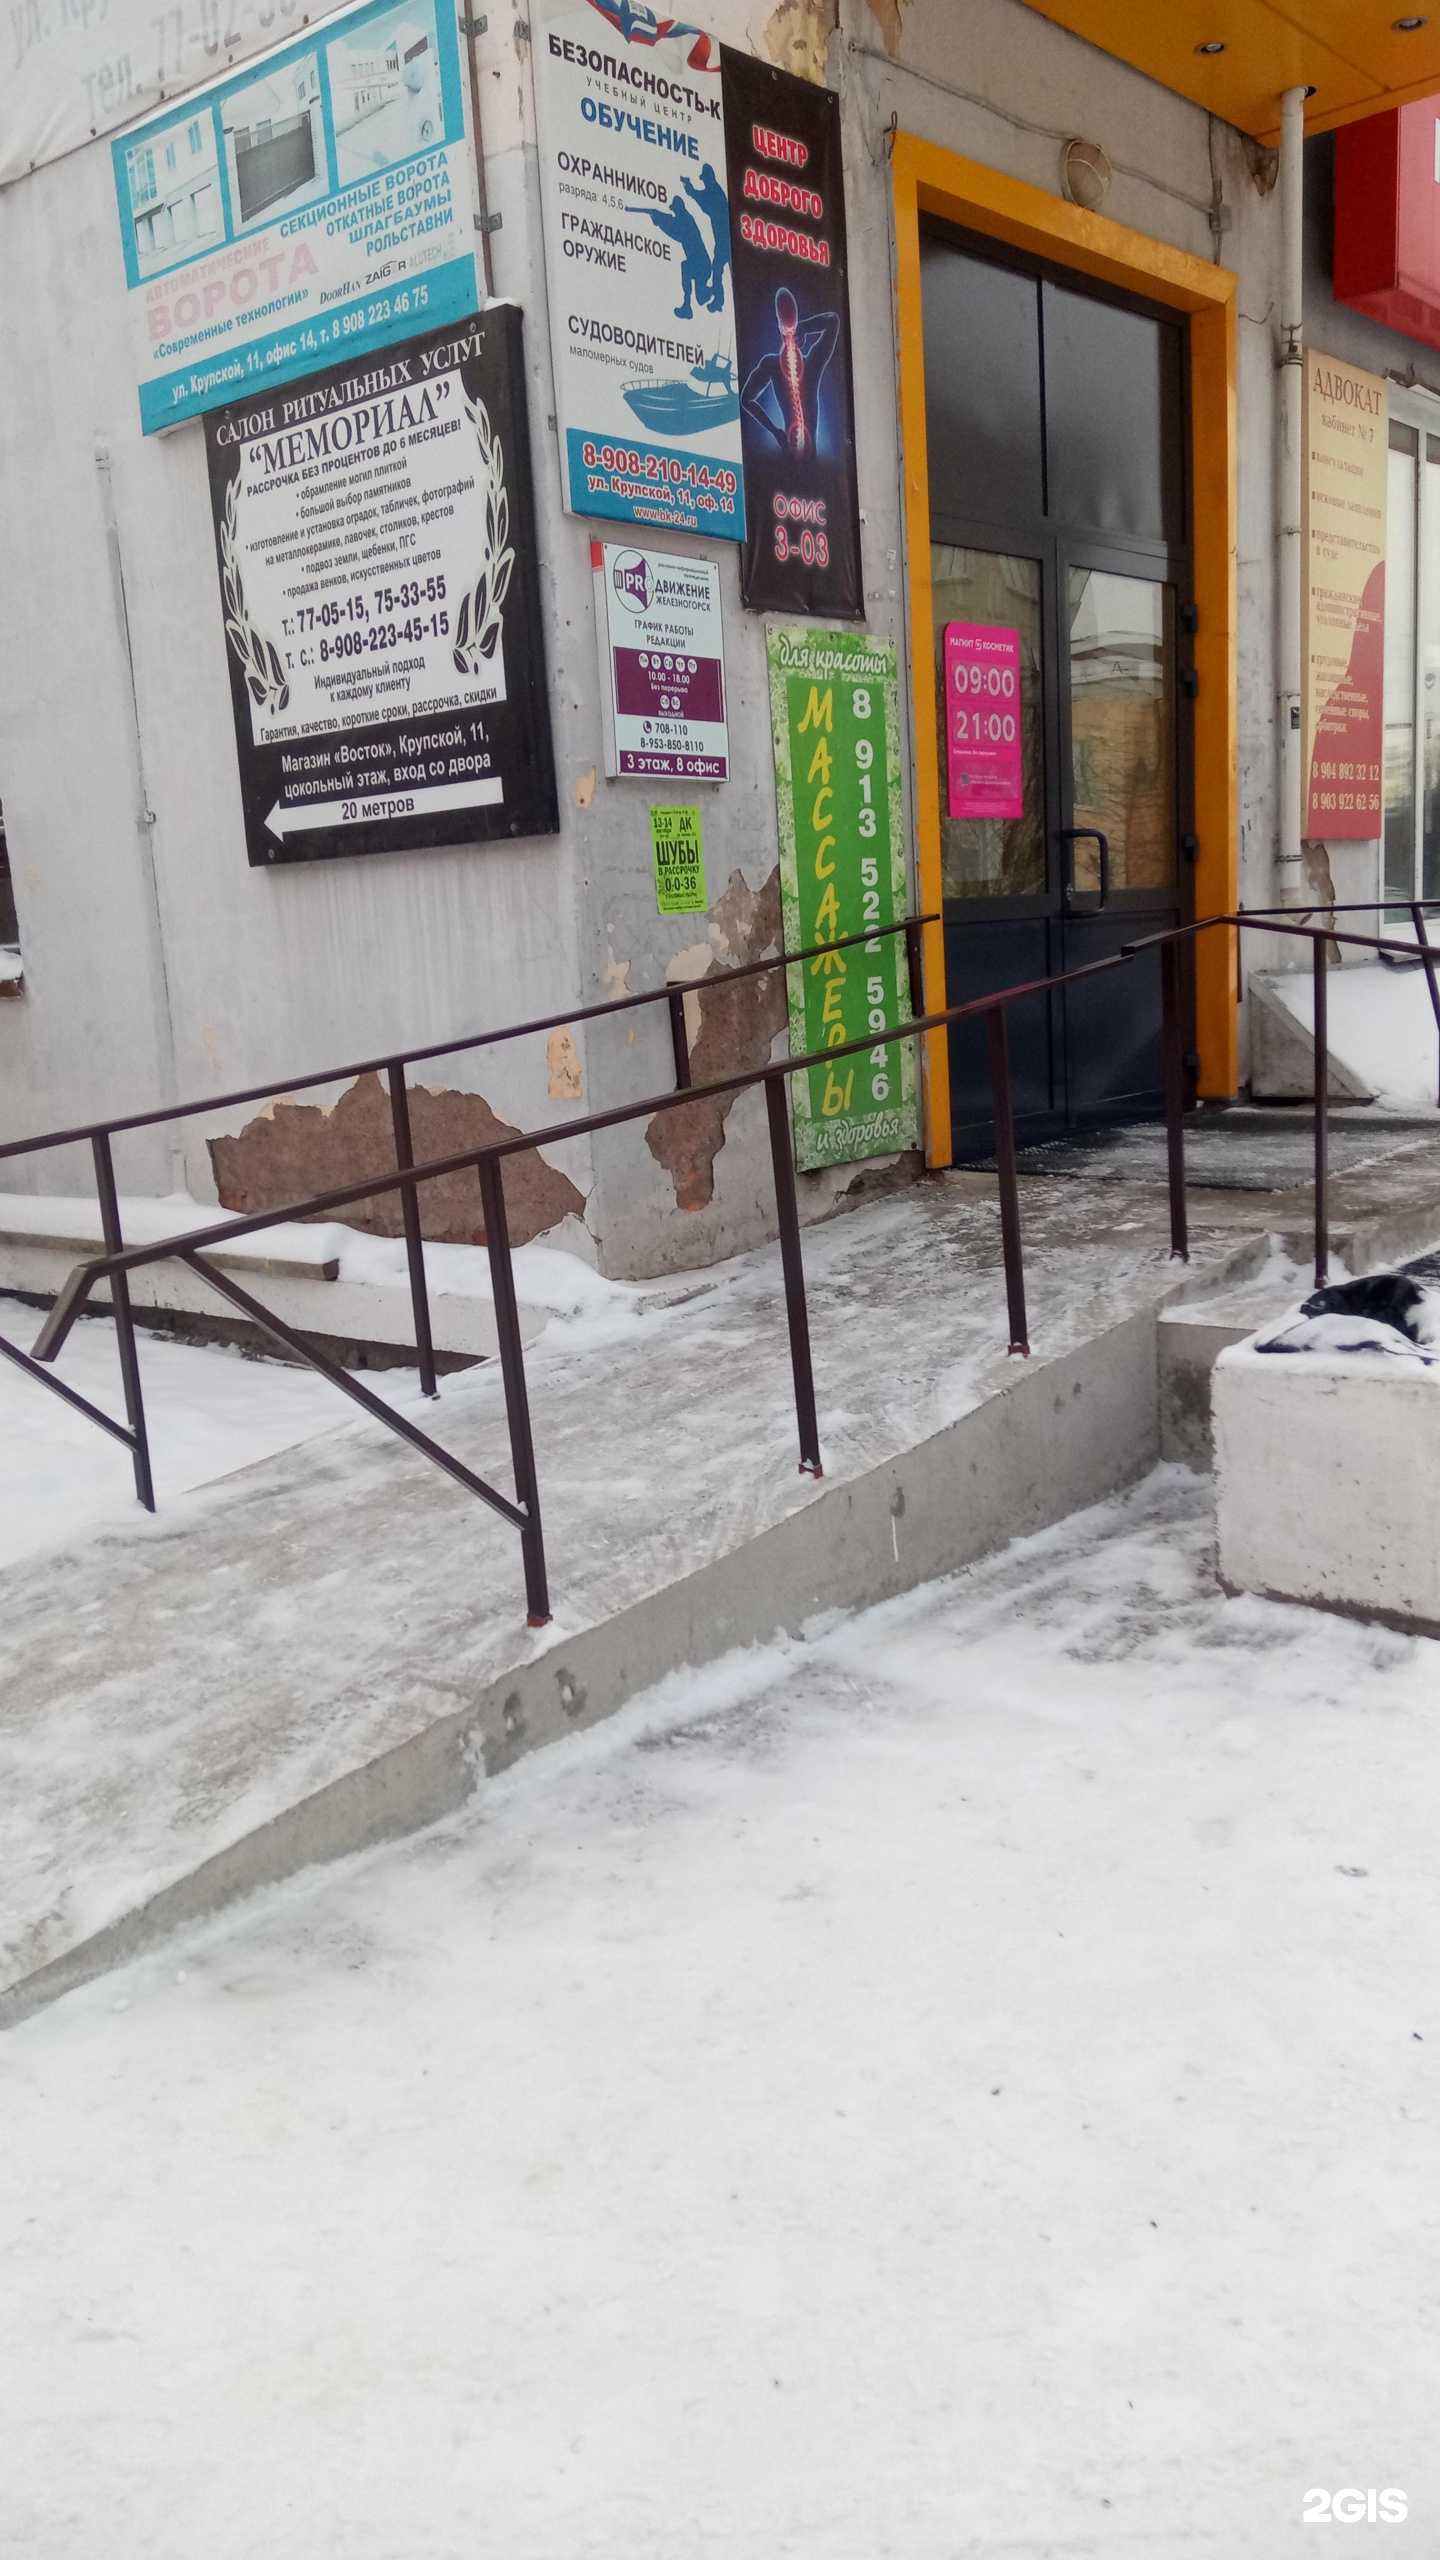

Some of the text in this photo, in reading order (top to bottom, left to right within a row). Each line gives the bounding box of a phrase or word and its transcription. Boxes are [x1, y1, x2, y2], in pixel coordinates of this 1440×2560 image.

[80, 53, 143, 121] тел.
[548, 33, 722, 121] БЕЗОПАСНОСТЬ-К
[586, 76, 693, 125] УЧЕБНЫЙ ЦЕНТР
[580, 97, 700, 162] ОБУЧЕНИЕ
[752, 124, 809, 168] ЦЕНТР
[280, 151, 448, 238] СЕКЦИОННЫЕ ВОРОТА
[557, 151, 668, 204] ОХРАННИКОВ
[744, 168, 823, 219] ДОБРОГО
[326, 171, 450, 237] ОТКАТНЫЕ ВОРОТА
[349, 189, 452, 244] ШЛАГБАУМЫ
[366, 207, 453, 257] РОЛЬСТАВНИ
[561, 212, 672, 262] ГРАЖДАНСКОЕ
[740, 213, 830, 268] ЗДОРОВЬЯ
[563, 240, 627, 273] ОРУЖИЕ
[147, 241, 319, 342] ВОРОТА
[153, 288, 309, 360] «Современные технологии»
[172, 285, 429, 405] ул. Крупской, 11, офис 14, т. 8 908 223 46 75
[568, 315, 705, 367] СУДОВОДИТЕЛЕЙ
[570, 346, 654, 374] маломерных судов
[216, 332, 486, 446] САЛОН РИТУАЛЬНЫХ УСЛУГ
[1313, 366, 1382, 416] АДВОКАТ
[247, 419, 461, 497] РАССРОЧКА БЕЗ ПРОЦЕНТОВ ДО 6 МЕСЯЦЕВ!
[301, 456, 407, 500] обрамление могил плиткой
[583, 442, 737, 494] 8-908-210-14-49
[250, 475, 475, 553] изготовление установка оградок, табличек, фотографий
[300, 478, 411, 520] большой выбор памятников
[588, 476, 735, 514] ул. Крупской, 11, оф. 14
[773, 493, 828, 527] ОФИС
[265, 504, 454, 567] на металлокерамике, лавочек, столиков, крестов
[306, 532, 416, 574] подвоз земли, щебенки, ПГС
[774, 525, 830, 568] 3-03
[287, 549, 441, 598] продажа венков, искусственных цветов
[625, 573, 646, 592] PR
[655, 579, 710, 600] ДВИЖЕНИЕ
[297, 594, 370, 633] 77-05-15,
[375, 575, 447, 614] 75-33-55
[656, 596, 711, 612] ЖЕЛЕЗНОГОРСК
[319, 611, 449, 662] 8-908-223-45-15
[634, 619, 694, 636] ГРАФИК РАБОТЫ
[646, 635, 686, 649] РЕДАКЦИИ
[314, 656, 425, 690] Индивидуальный подход
[648, 671, 690, 684] 10.00 18.00
[779, 634, 888, 681] для красоты
[337, 676, 411, 701] каждому клиенту
[954, 664, 1015, 697] 09:00
[260, 687, 497, 743] Гарантия, качество, короткие сроки, рассрочка, скидки
[852, 688, 872, 719] 8
[956, 710, 1016, 742] 21:00
[281, 721, 489, 773] Магазин «Восток», Крупской, 11,
[640, 738, 704, 752] 8-953-850-8110
[655, 722, 688, 735] 708-110
[285, 753, 491, 800] цокольный этаж, вход со двора
[627, 753, 720, 775] 3 этаж, 8 офис
[1312, 761, 1318, 779] 8
[1369, 765, 1379, 781] 12
[341, 796, 415, 821] 20 метров
[1312, 792, 1318, 810] 8
[656, 840, 699, 866] ШУБЫ
[664, 865, 700, 876] РАССРОЧКУ
[816, 1111, 900, 1153] и здоровья
